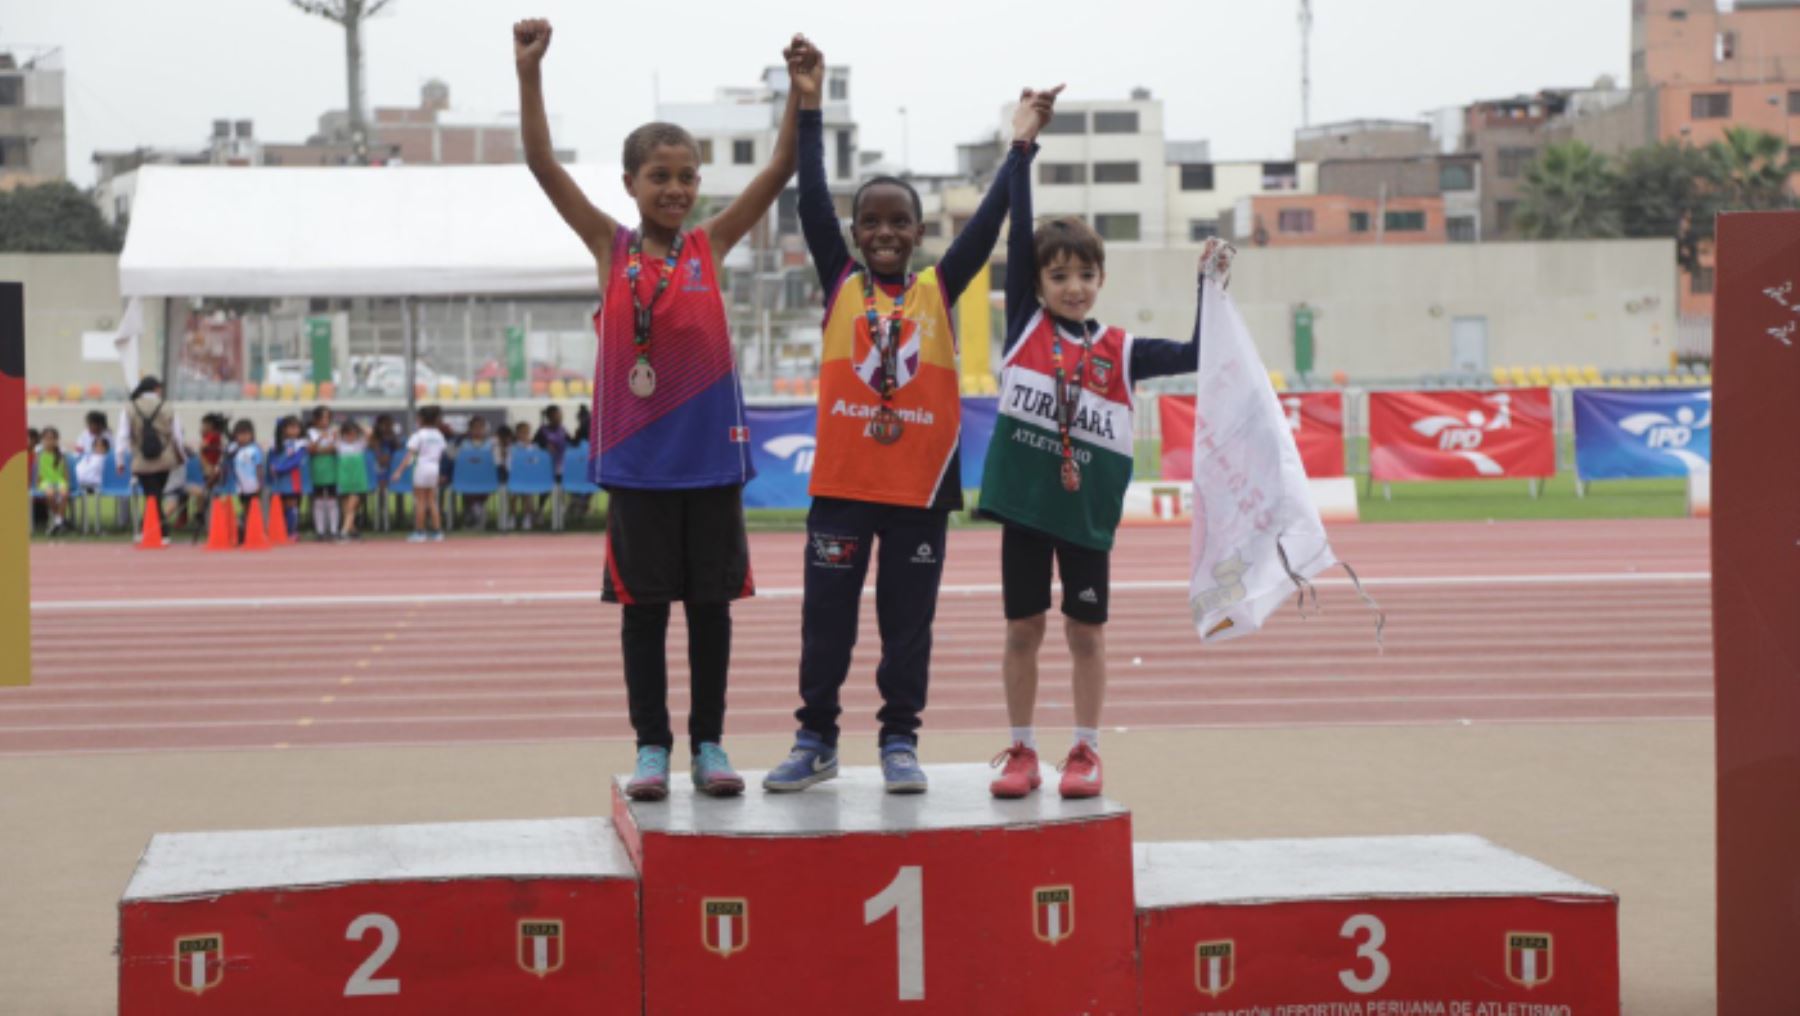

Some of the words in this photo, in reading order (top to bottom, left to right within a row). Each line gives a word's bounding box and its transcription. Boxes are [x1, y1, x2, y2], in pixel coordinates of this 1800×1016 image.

[1439, 429, 1483, 450] IPD
[1647, 426, 1692, 449] IPD
[343, 912, 401, 997] 2
[864, 865, 925, 1001] 1
[1338, 912, 1391, 994] 3
[1366, 1000, 1445, 1016] PERUANA
[1450, 1001, 1473, 1015] DE
[1476, 1002, 1572, 1016] ATLETISMO
